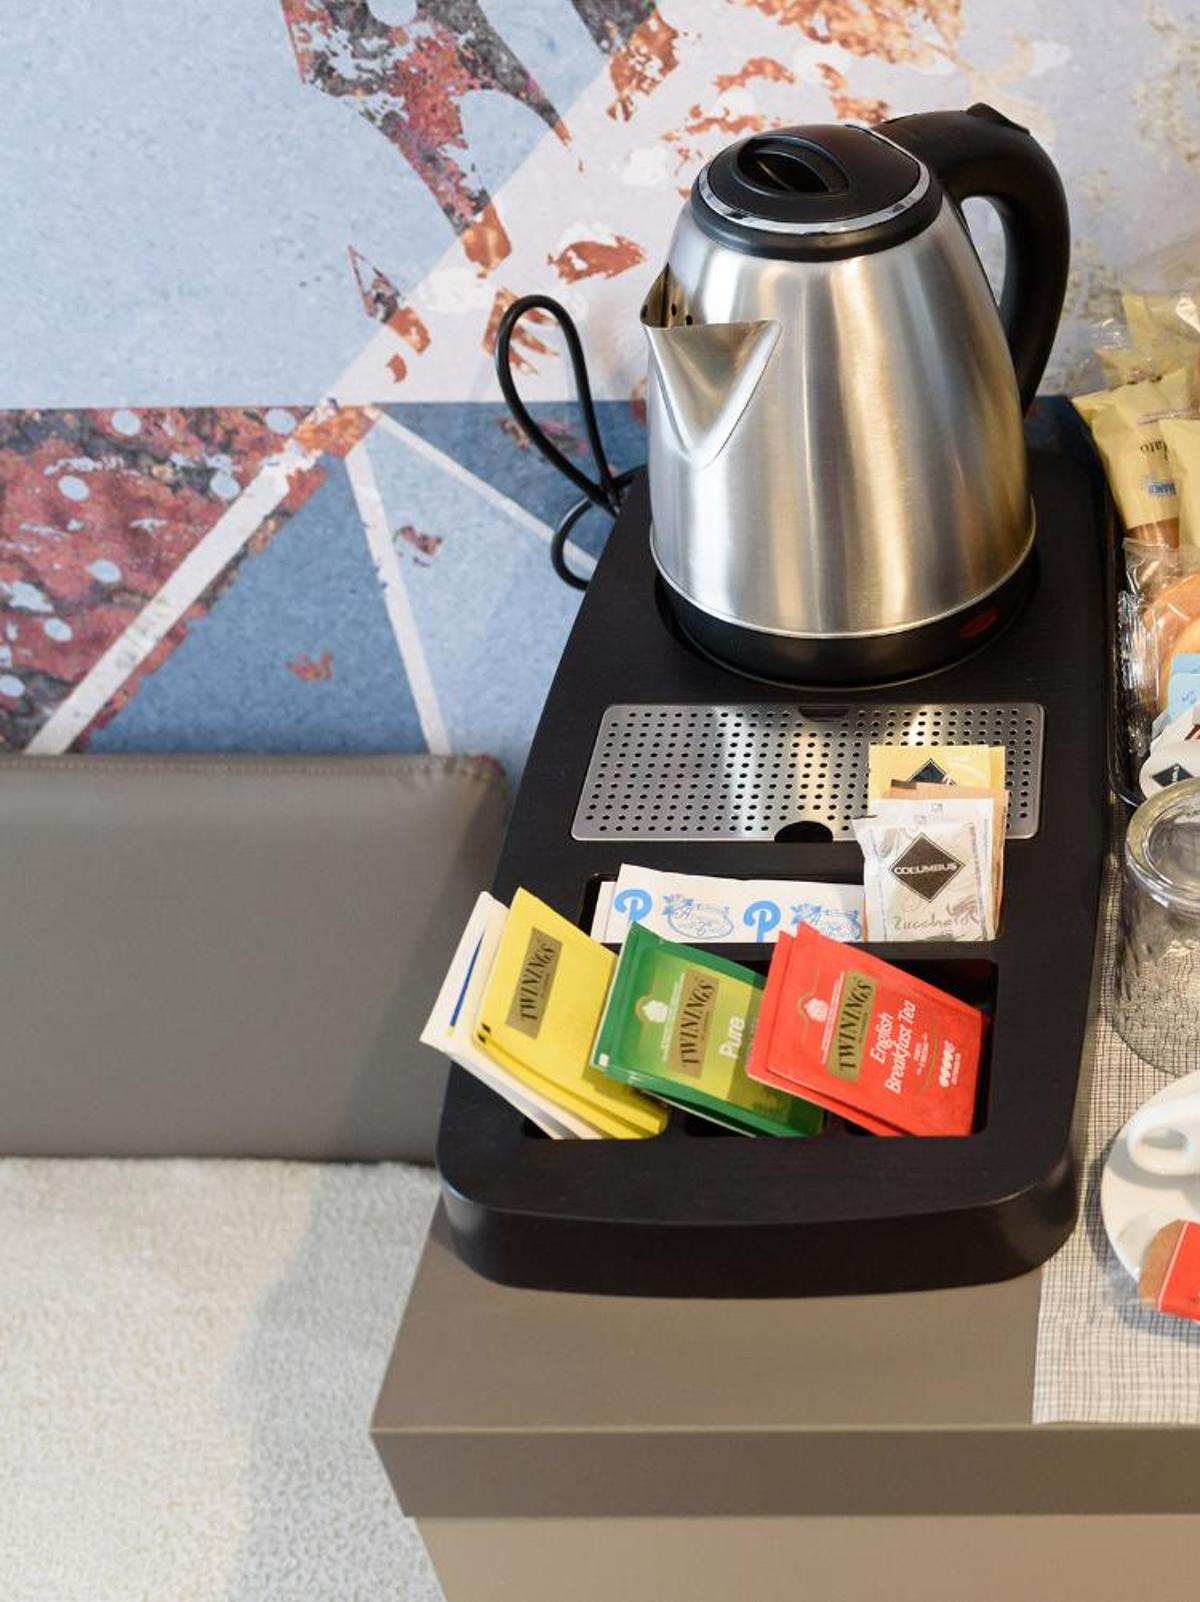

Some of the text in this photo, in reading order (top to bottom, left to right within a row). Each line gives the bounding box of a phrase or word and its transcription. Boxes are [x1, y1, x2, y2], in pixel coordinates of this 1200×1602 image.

[894, 862, 958, 875] COLUMBUS
[518, 940, 558, 1023] TWININGS
[680, 977, 715, 1067] TWININGS
[717, 1016, 745, 1061] Pure
[836, 977, 876, 1072] TWININGS
[870, 1012, 896, 1066] English
[884, 1000, 917, 1095] Breakfast Tea
